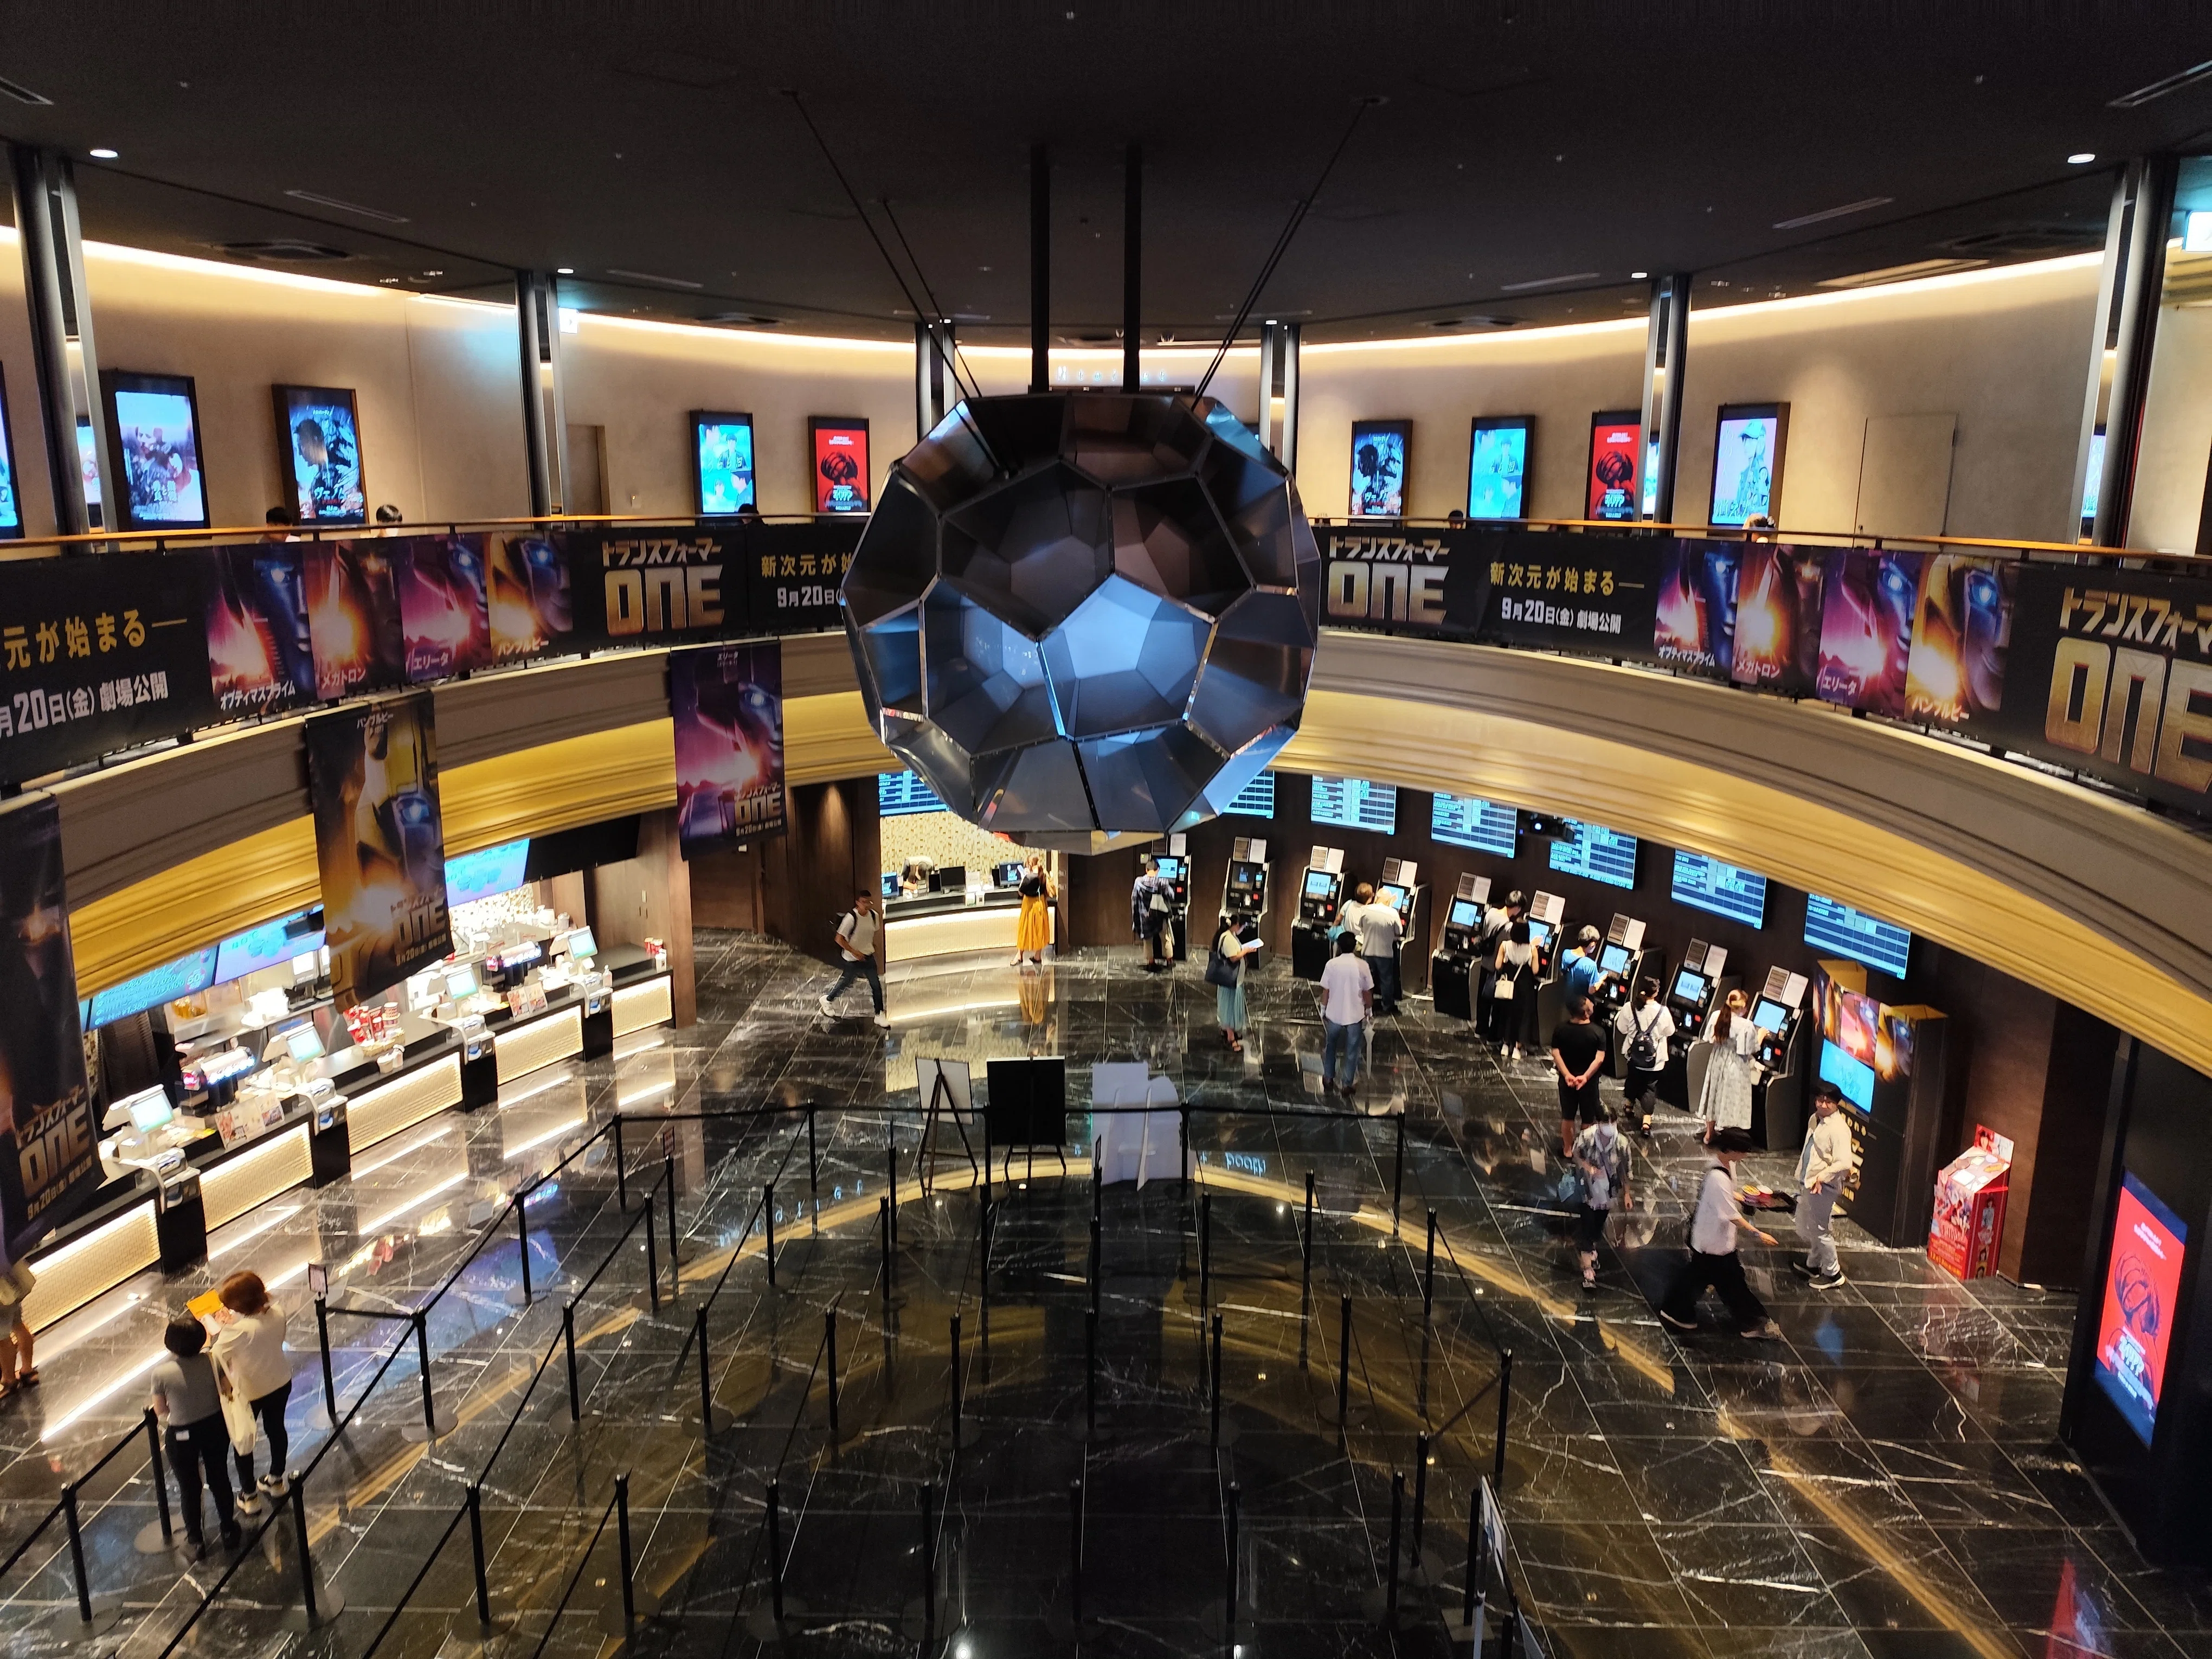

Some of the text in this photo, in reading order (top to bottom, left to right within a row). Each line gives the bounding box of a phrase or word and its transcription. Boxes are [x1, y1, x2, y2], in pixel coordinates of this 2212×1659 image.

[1078, 368, 1166, 382] toiet
[602, 538, 723, 567] トランスフォーマー
[1329, 536, 1450, 562] トランスフォーマー
[604, 564, 725, 636] ONE
[1327, 560, 1449, 625] ONE
[1501, 596, 1622, 635] 9月20日(金) 劇場公開
[413, 655, 449, 671] エリータ
[1658, 646, 1716, 667] オプティマスプライム
[1736, 658, 1781, 679] メガトロン
[99, 670, 169, 713] 劇場公開
[320, 666, 367, 689] メガトロン
[1822, 674, 1857, 697] エリータ
[220, 679, 296, 711] オプティマスプライム
[2045, 636, 2212, 794] ONE
[735, 791, 782, 825] ONE
[19, 1101, 91, 1198] ONE
